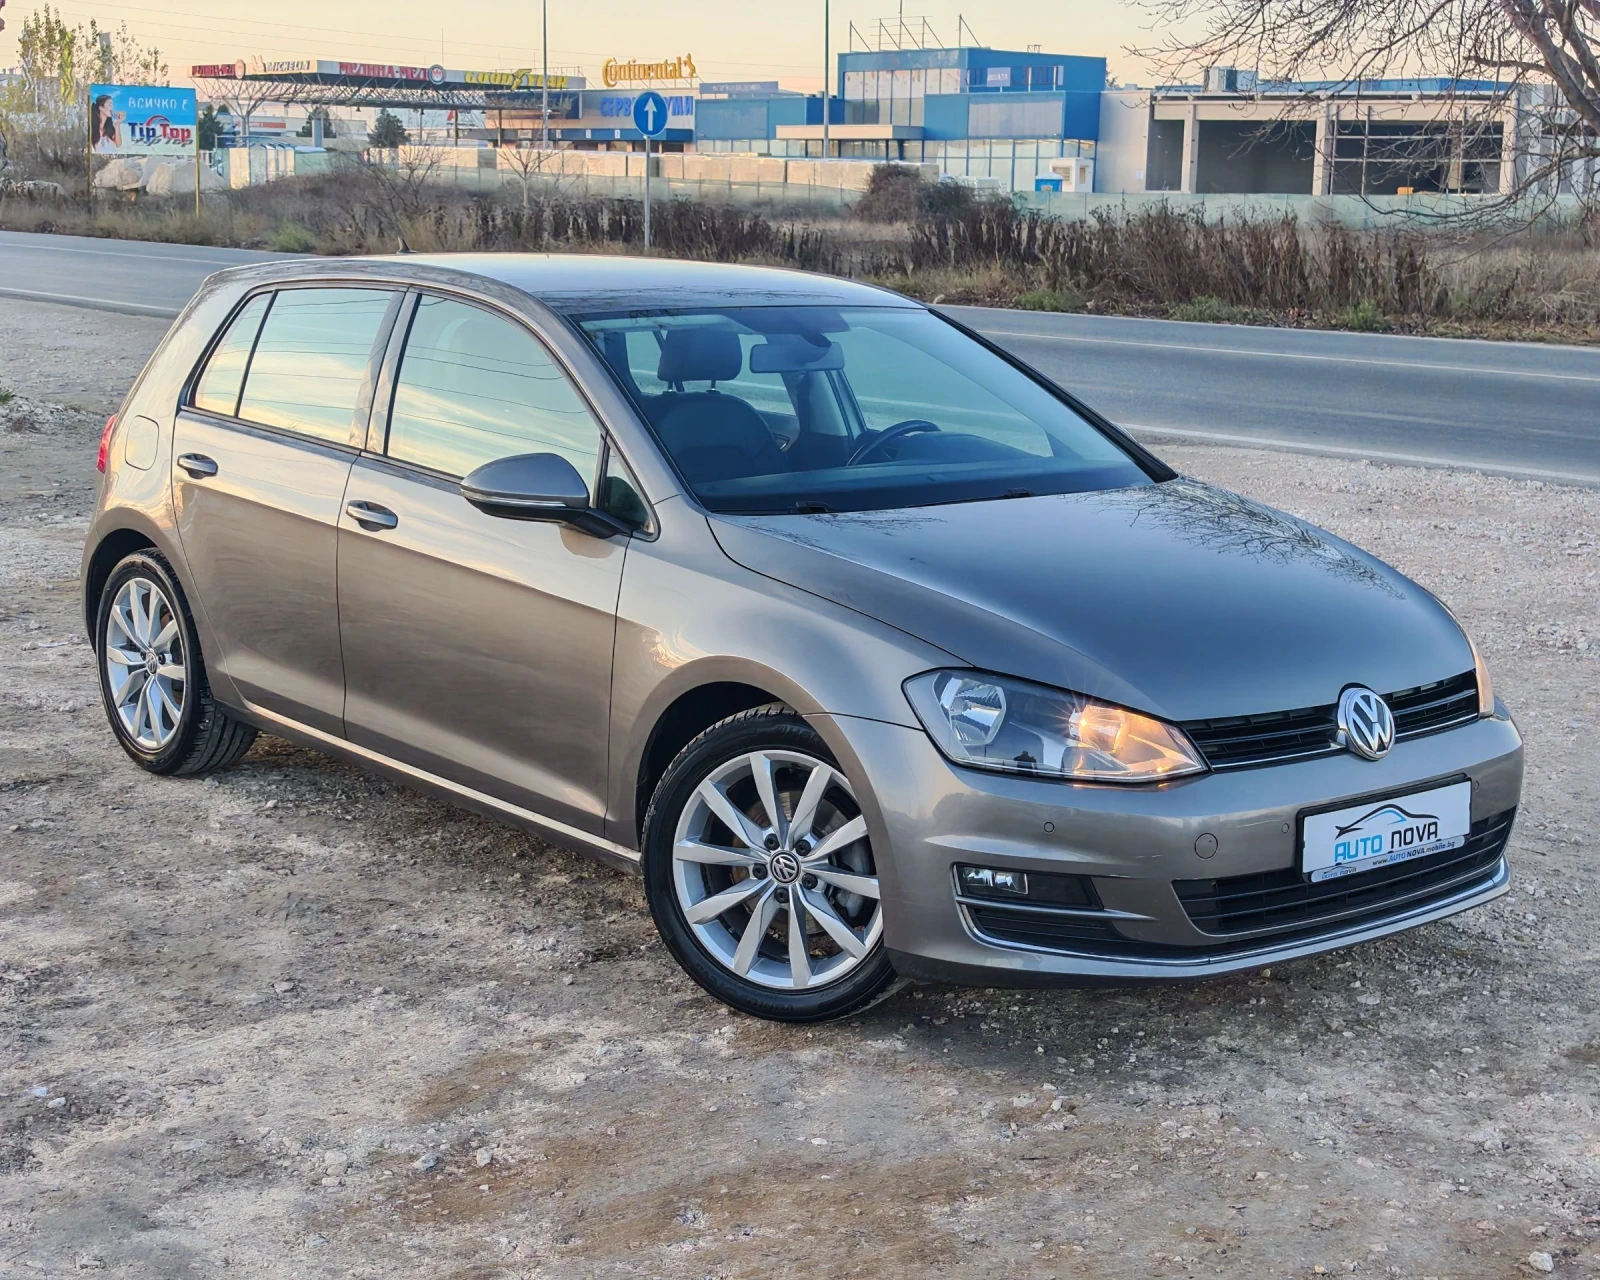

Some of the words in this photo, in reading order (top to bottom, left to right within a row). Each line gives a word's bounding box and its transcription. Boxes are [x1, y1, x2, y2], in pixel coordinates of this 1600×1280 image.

[602, 57, 682, 88] Continental
[128, 96, 177, 110] ВСИЧКО
[601, 96, 637, 117] СЕРВ
[663, 96, 694, 116] УМИ
[128, 122, 156, 142] Tip
[160, 123, 192, 143] Top
[1334, 834, 1383, 862] AUTO
